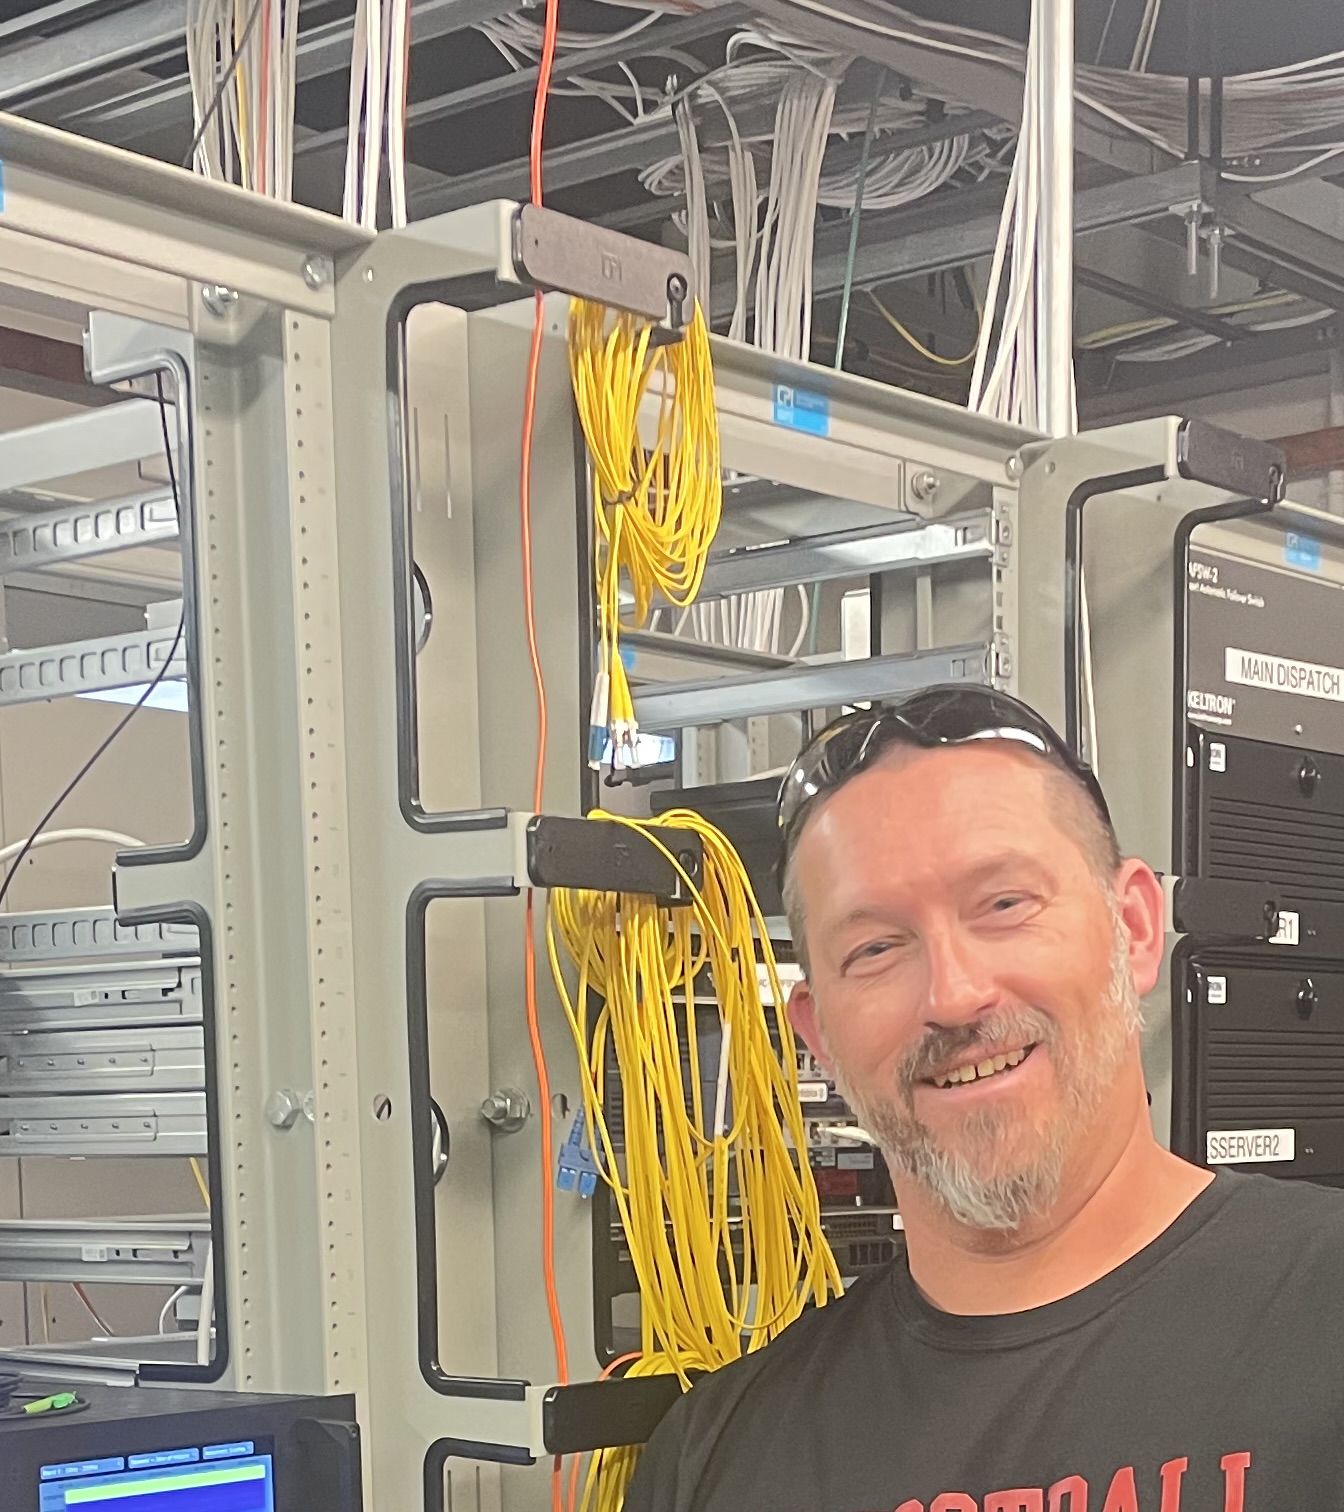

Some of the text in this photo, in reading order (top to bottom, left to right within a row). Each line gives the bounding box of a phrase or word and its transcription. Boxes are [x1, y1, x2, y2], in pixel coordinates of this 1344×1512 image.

[1240, 655, 1274, 684] MAIN
[1276, 664, 1341, 696] DISPATCH
[1207, 1134, 1280, 1160] SSERVER2
